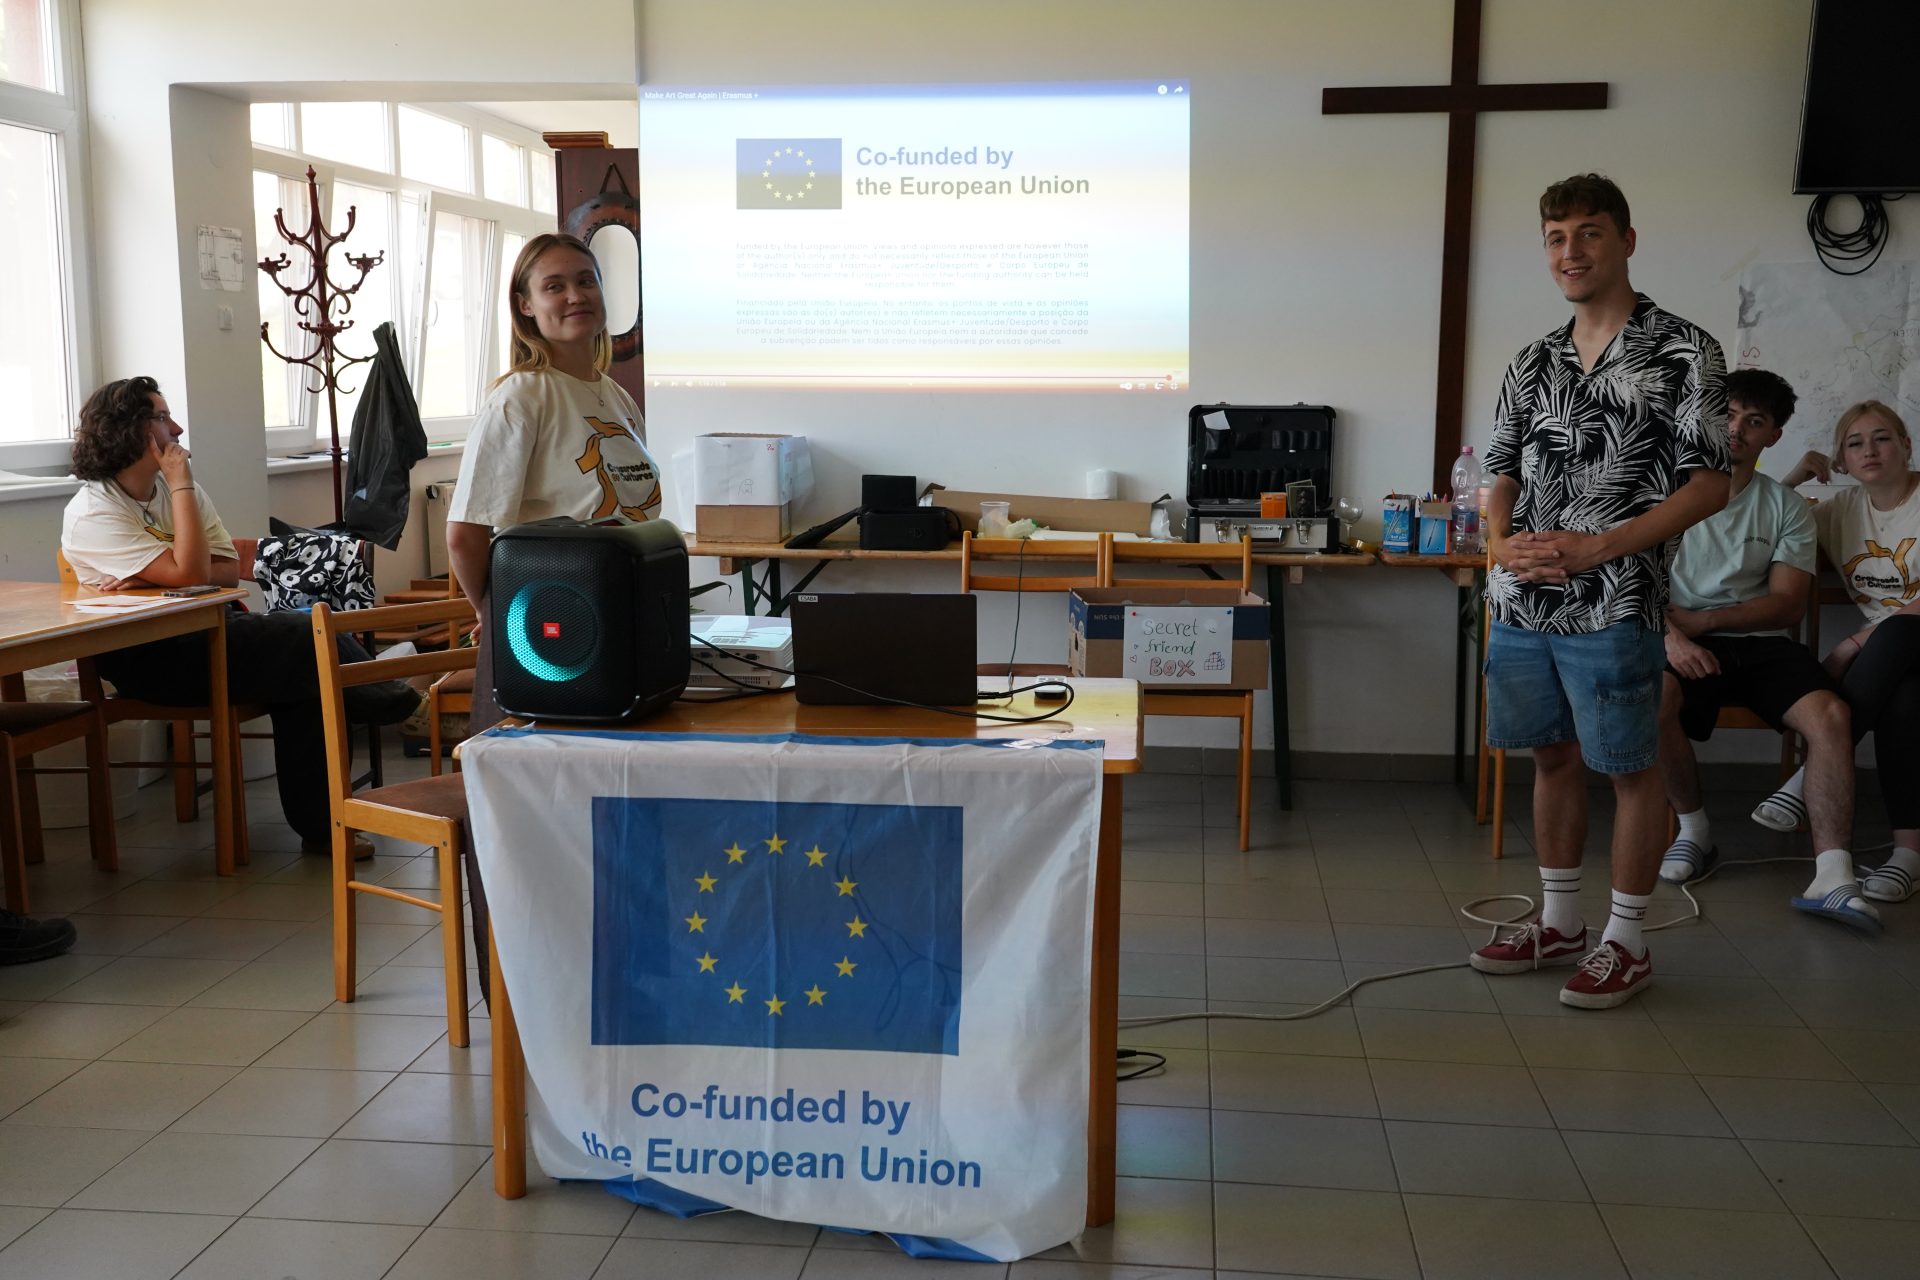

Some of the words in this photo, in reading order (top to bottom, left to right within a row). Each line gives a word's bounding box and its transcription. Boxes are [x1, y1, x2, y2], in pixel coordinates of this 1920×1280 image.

[644, 91, 664, 99] Make
[665, 91, 676, 99] Art
[677, 91, 696, 99] Great
[698, 91, 717, 101] Again
[722, 91, 753, 99] Erasmus
[856, 146, 978, 167] Co-funded
[985, 147, 1014, 170] by
[856, 176, 892, 196] the
[899, 175, 1013, 199] European
[1020, 175, 1090, 195] Union
[620, 471, 654, 482] Cultures
[1854, 574, 1900, 583] Crossroads
[1867, 580, 1902, 589] Cultures
[1144, 640, 1196, 656] friend
[1149, 657, 1196, 678] BOX
[631, 1083, 846, 1125] Co-funded
[861, 1090, 911, 1136] by
[582, 1130, 632, 1168] the
[646, 1137, 845, 1185] European
[860, 1146, 983, 1188] Union
